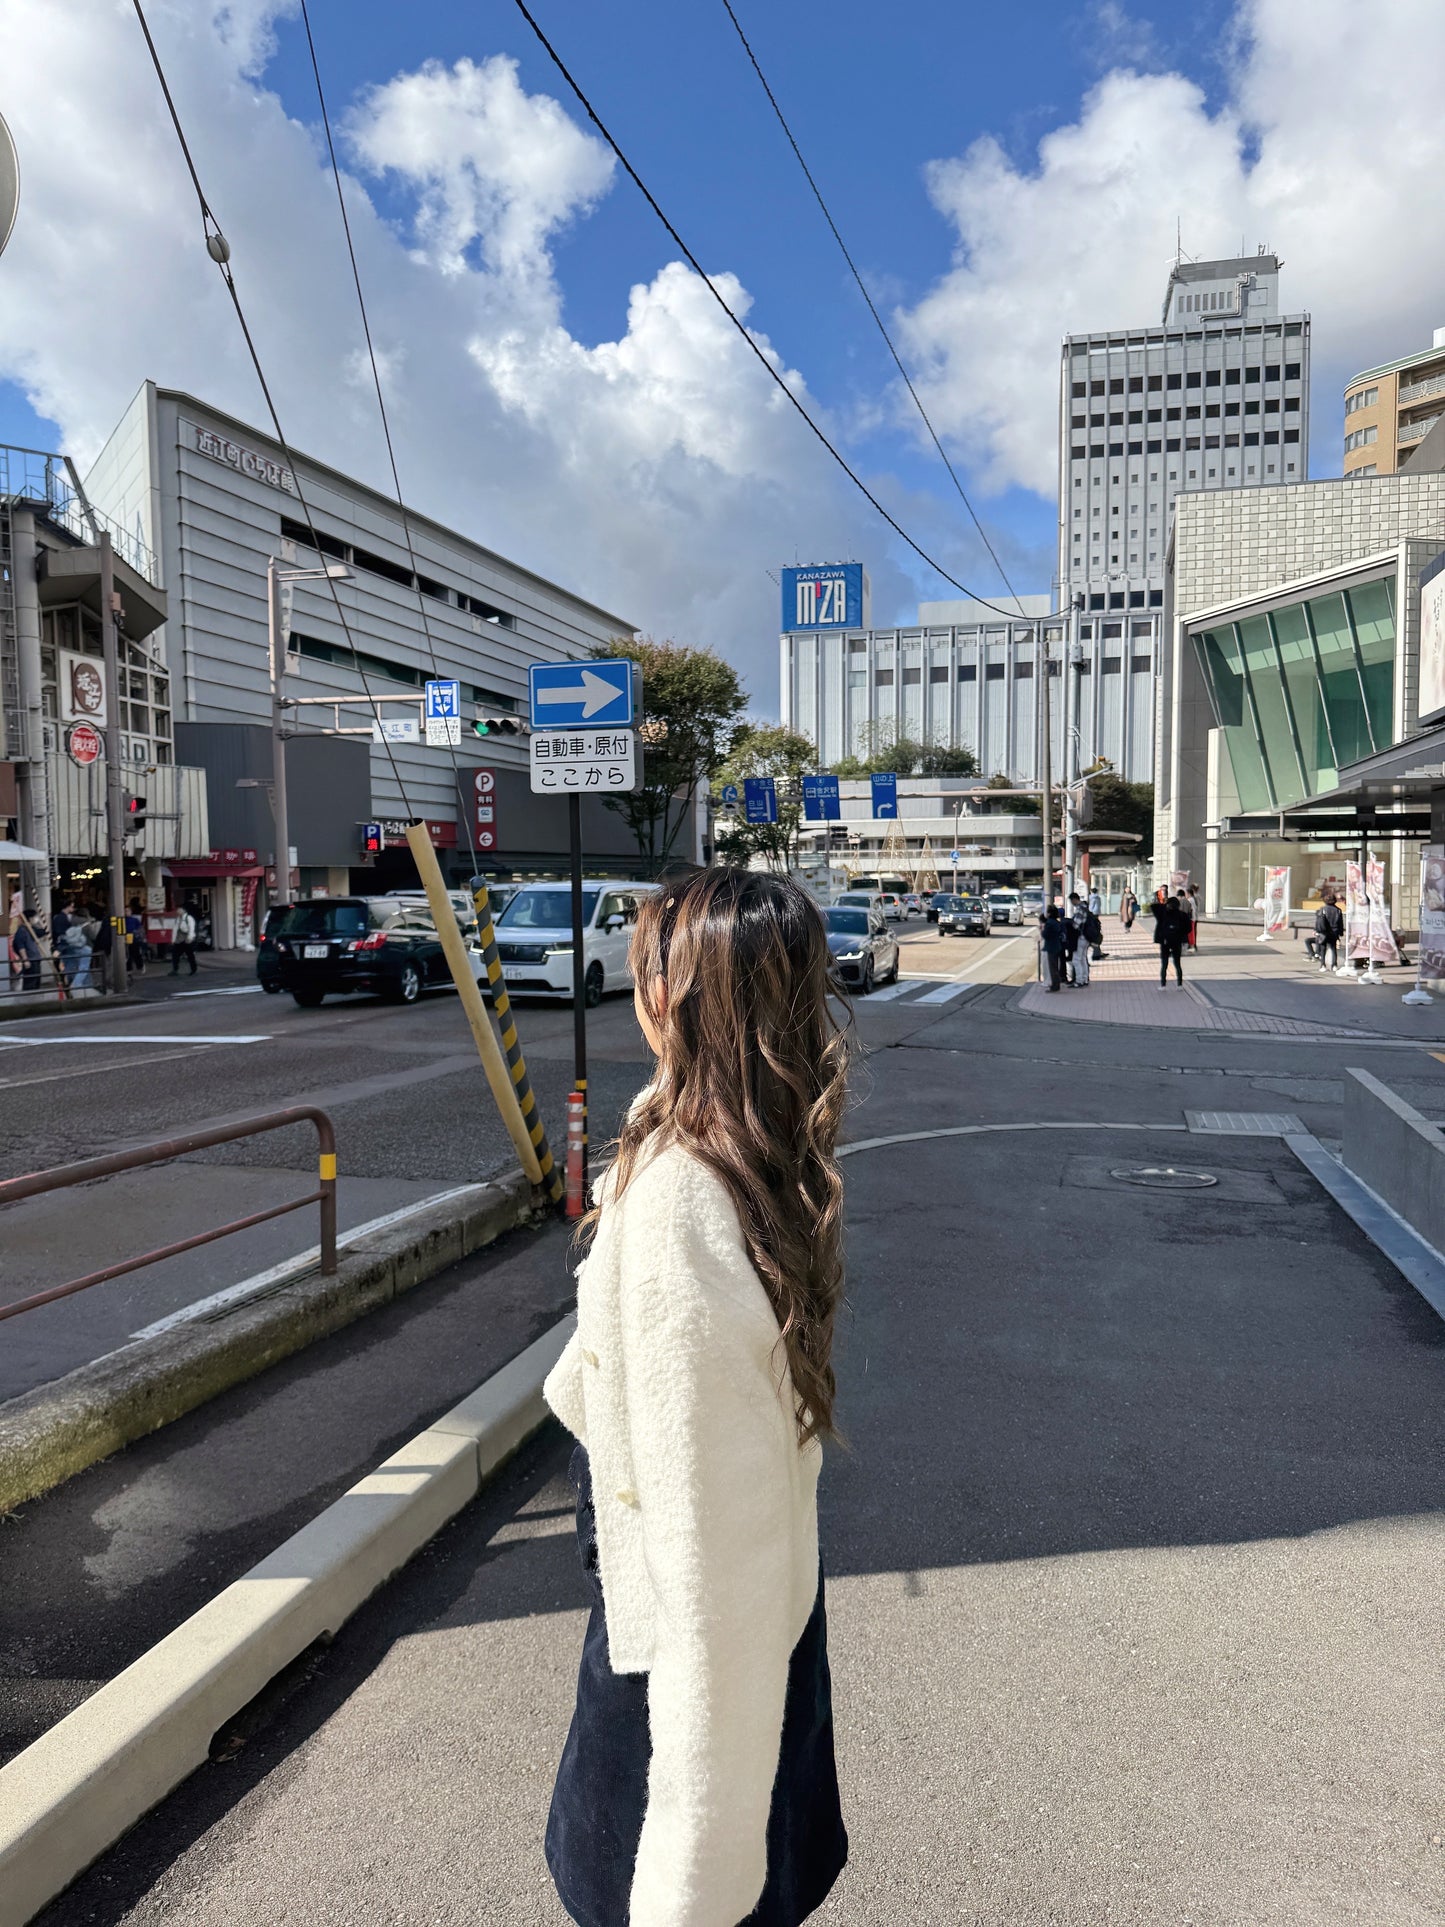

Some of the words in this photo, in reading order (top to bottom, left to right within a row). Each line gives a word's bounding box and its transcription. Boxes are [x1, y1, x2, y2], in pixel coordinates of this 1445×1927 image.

[197, 431, 294, 492] 近江町いちば館
[796, 571, 845, 581] KANAZAWA
[535, 736, 629, 758] 自動車・原付
[481, 775, 490, 790] P
[541, 767, 625, 787] ここから
[367, 826, 377, 838] P
